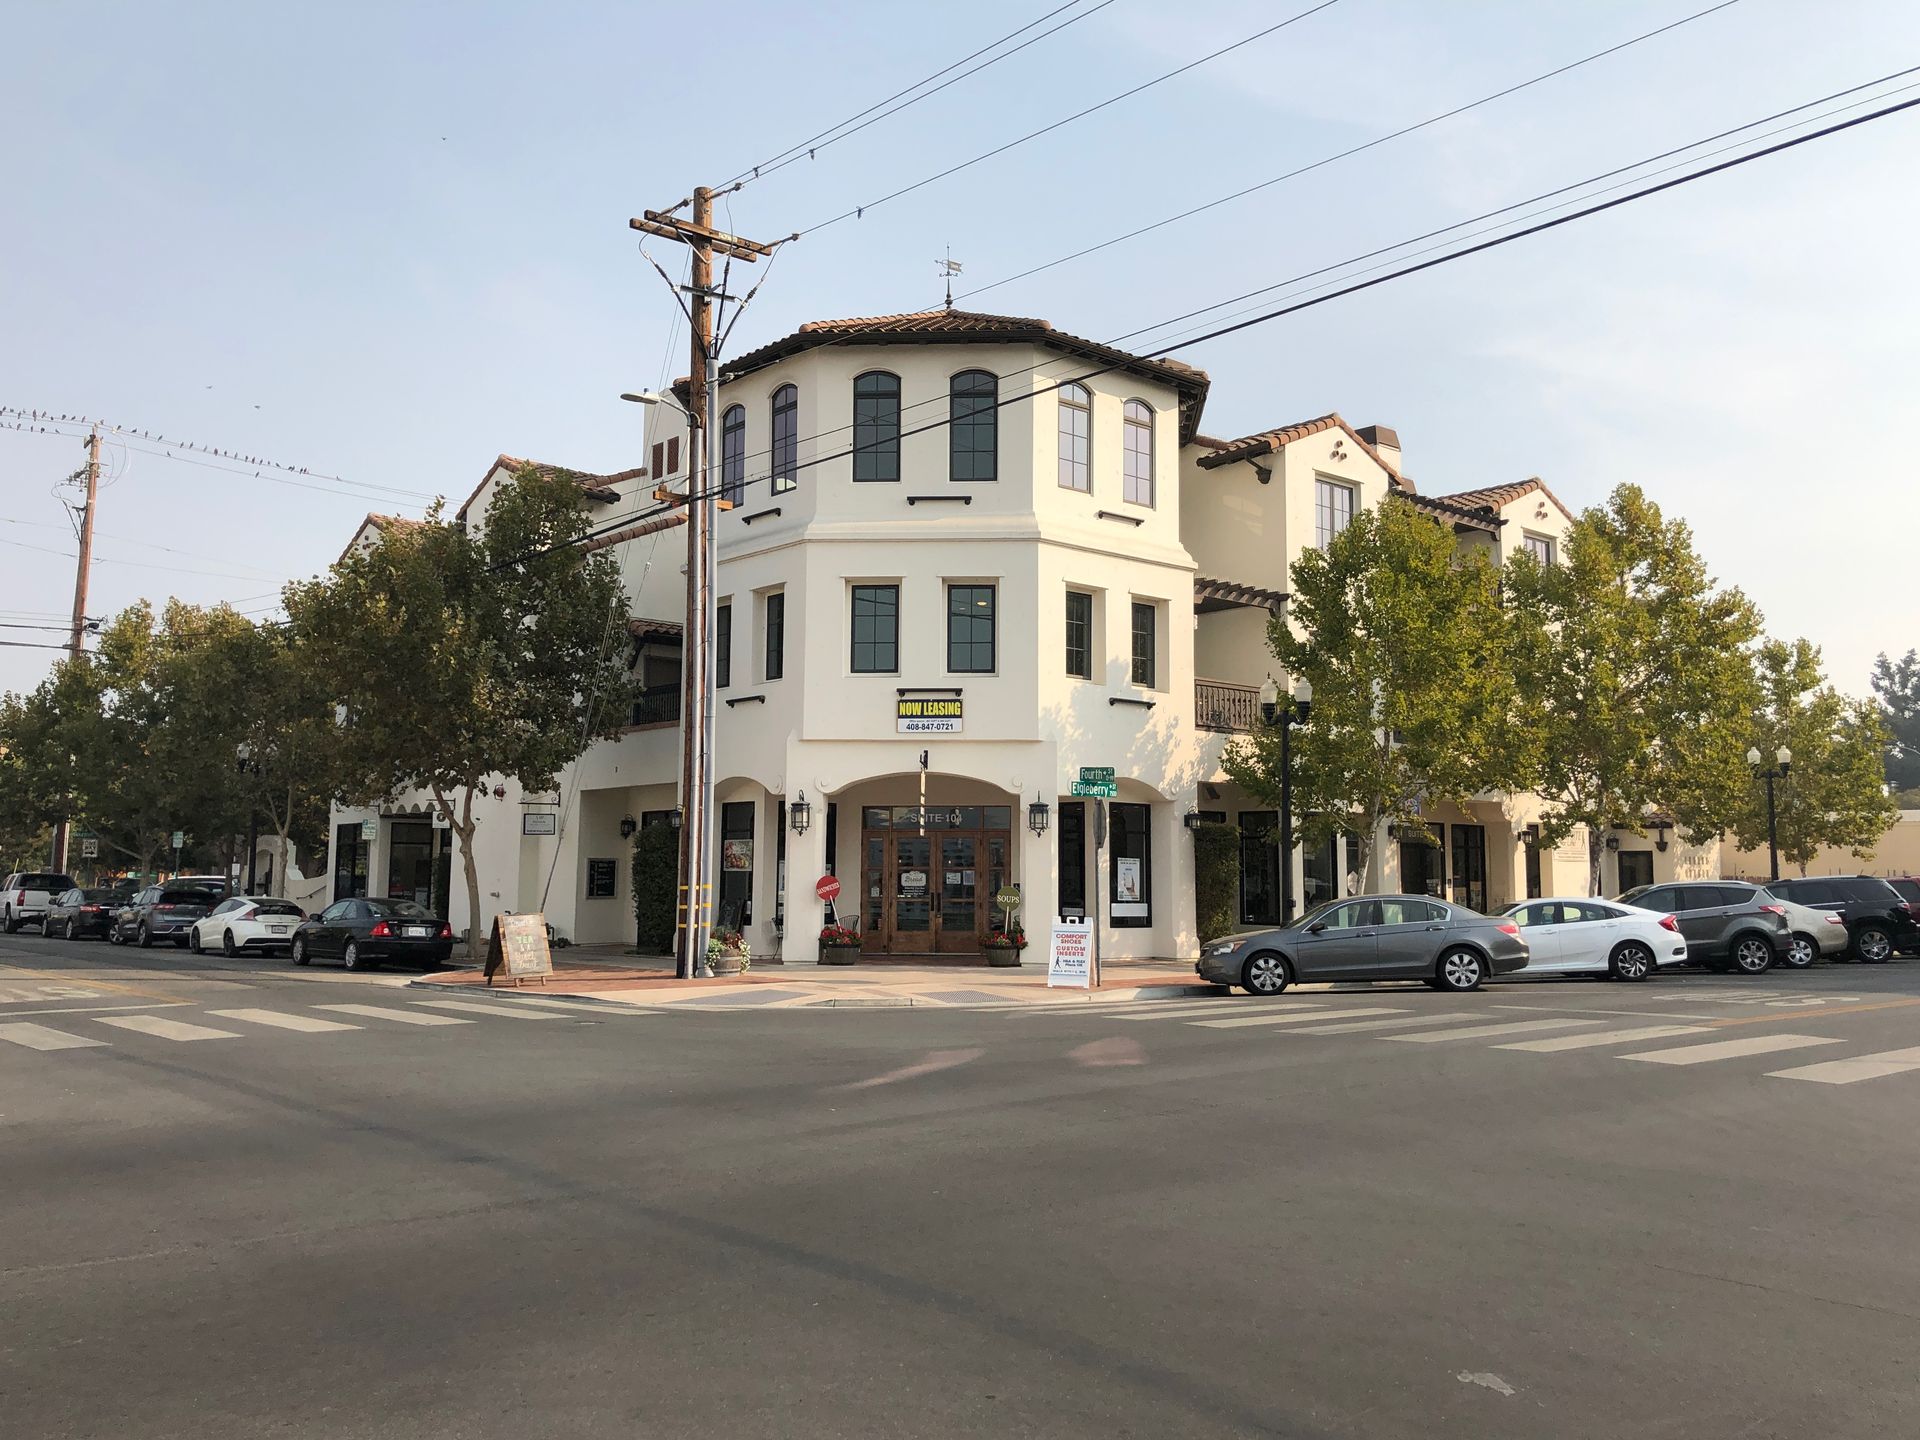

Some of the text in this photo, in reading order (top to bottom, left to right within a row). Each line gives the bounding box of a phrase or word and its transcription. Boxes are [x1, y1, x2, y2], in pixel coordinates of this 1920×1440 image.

[899, 701, 961, 716] NOW LEASING
[906, 723, 953, 731] 408-847-0721
[1081, 769, 1103, 780] Fourth
[997, 895, 1020, 903] SOUPS
